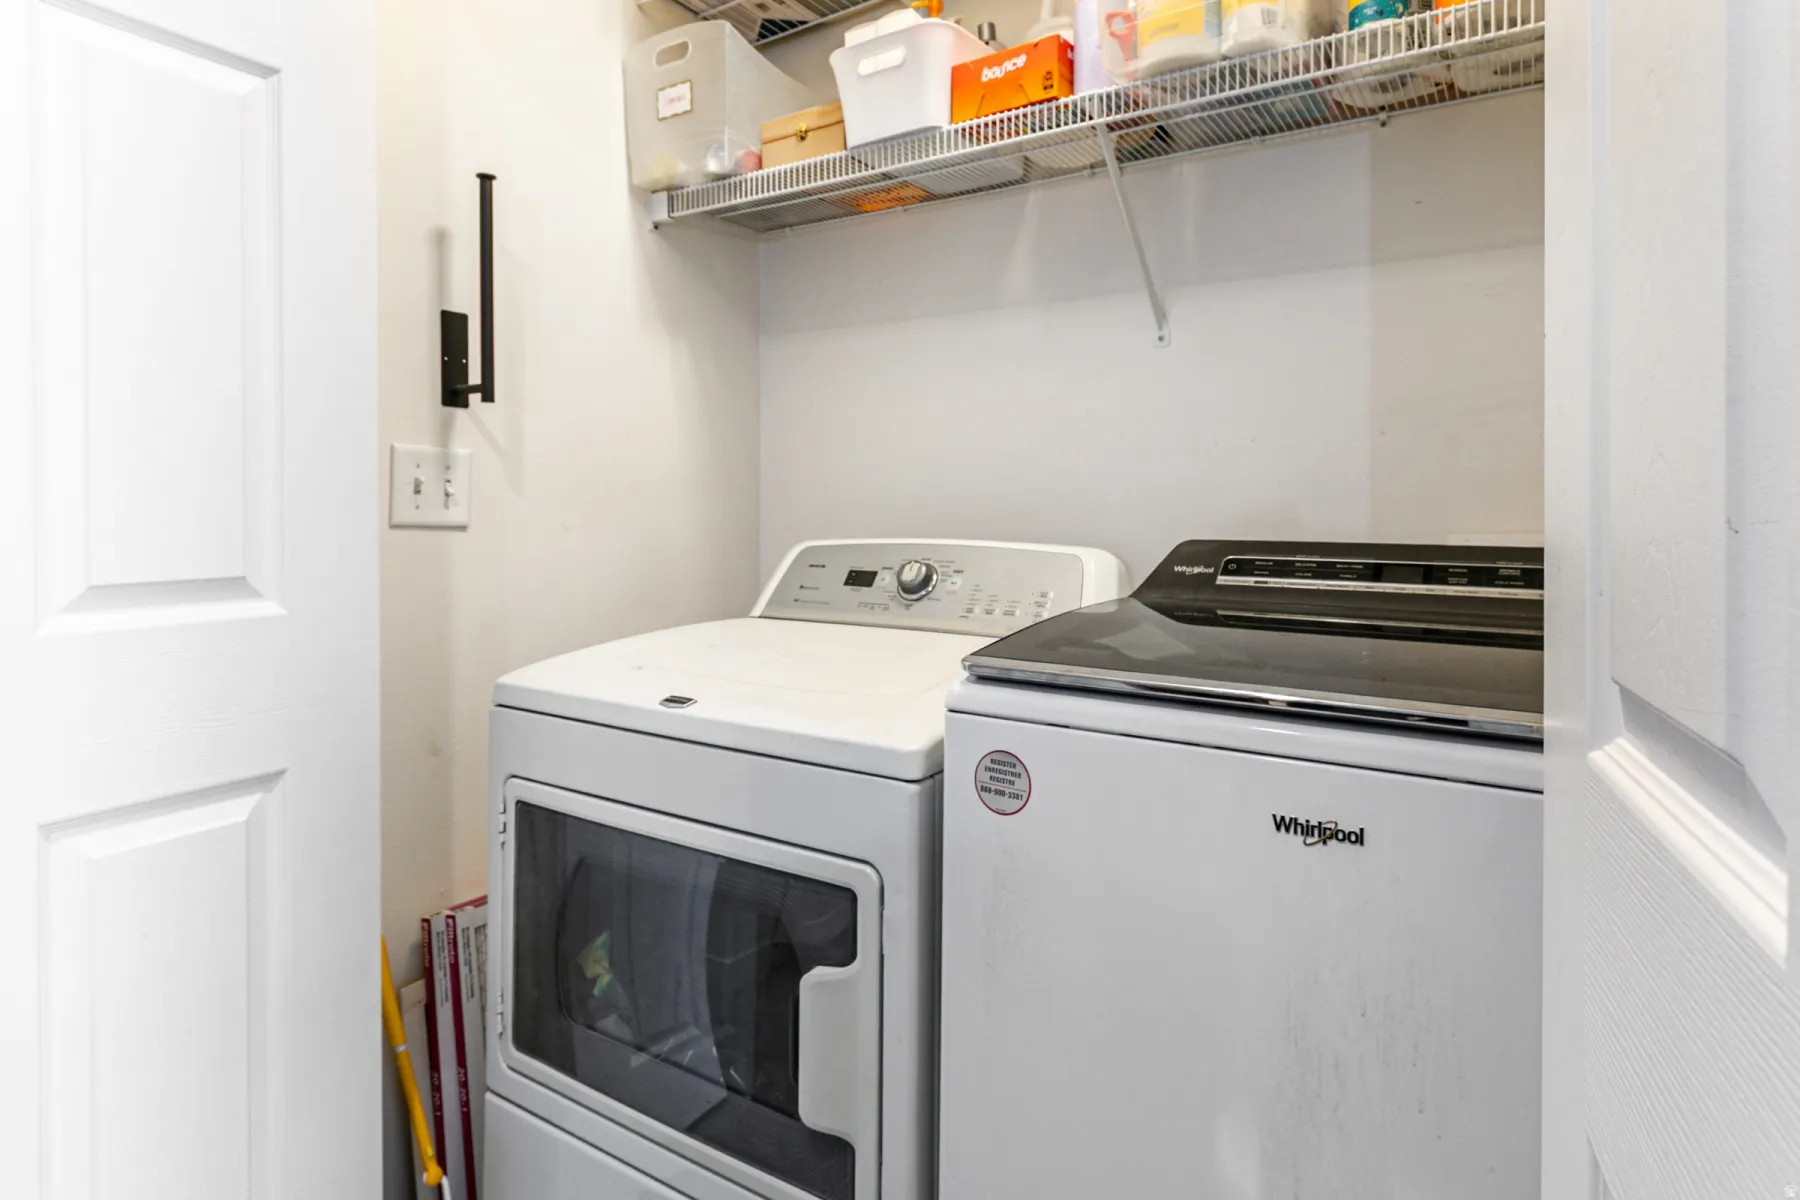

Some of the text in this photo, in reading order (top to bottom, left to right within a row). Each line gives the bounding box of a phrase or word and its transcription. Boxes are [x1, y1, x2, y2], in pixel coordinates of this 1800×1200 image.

[981, 53, 1027, 82] bounce
[1174, 565, 1214, 575] Whirlpool
[990, 758, 1017, 769] REGISTER
[984, 765, 1022, 779] ENREGISTRER
[1272, 813, 1364, 846] Whirlpool
